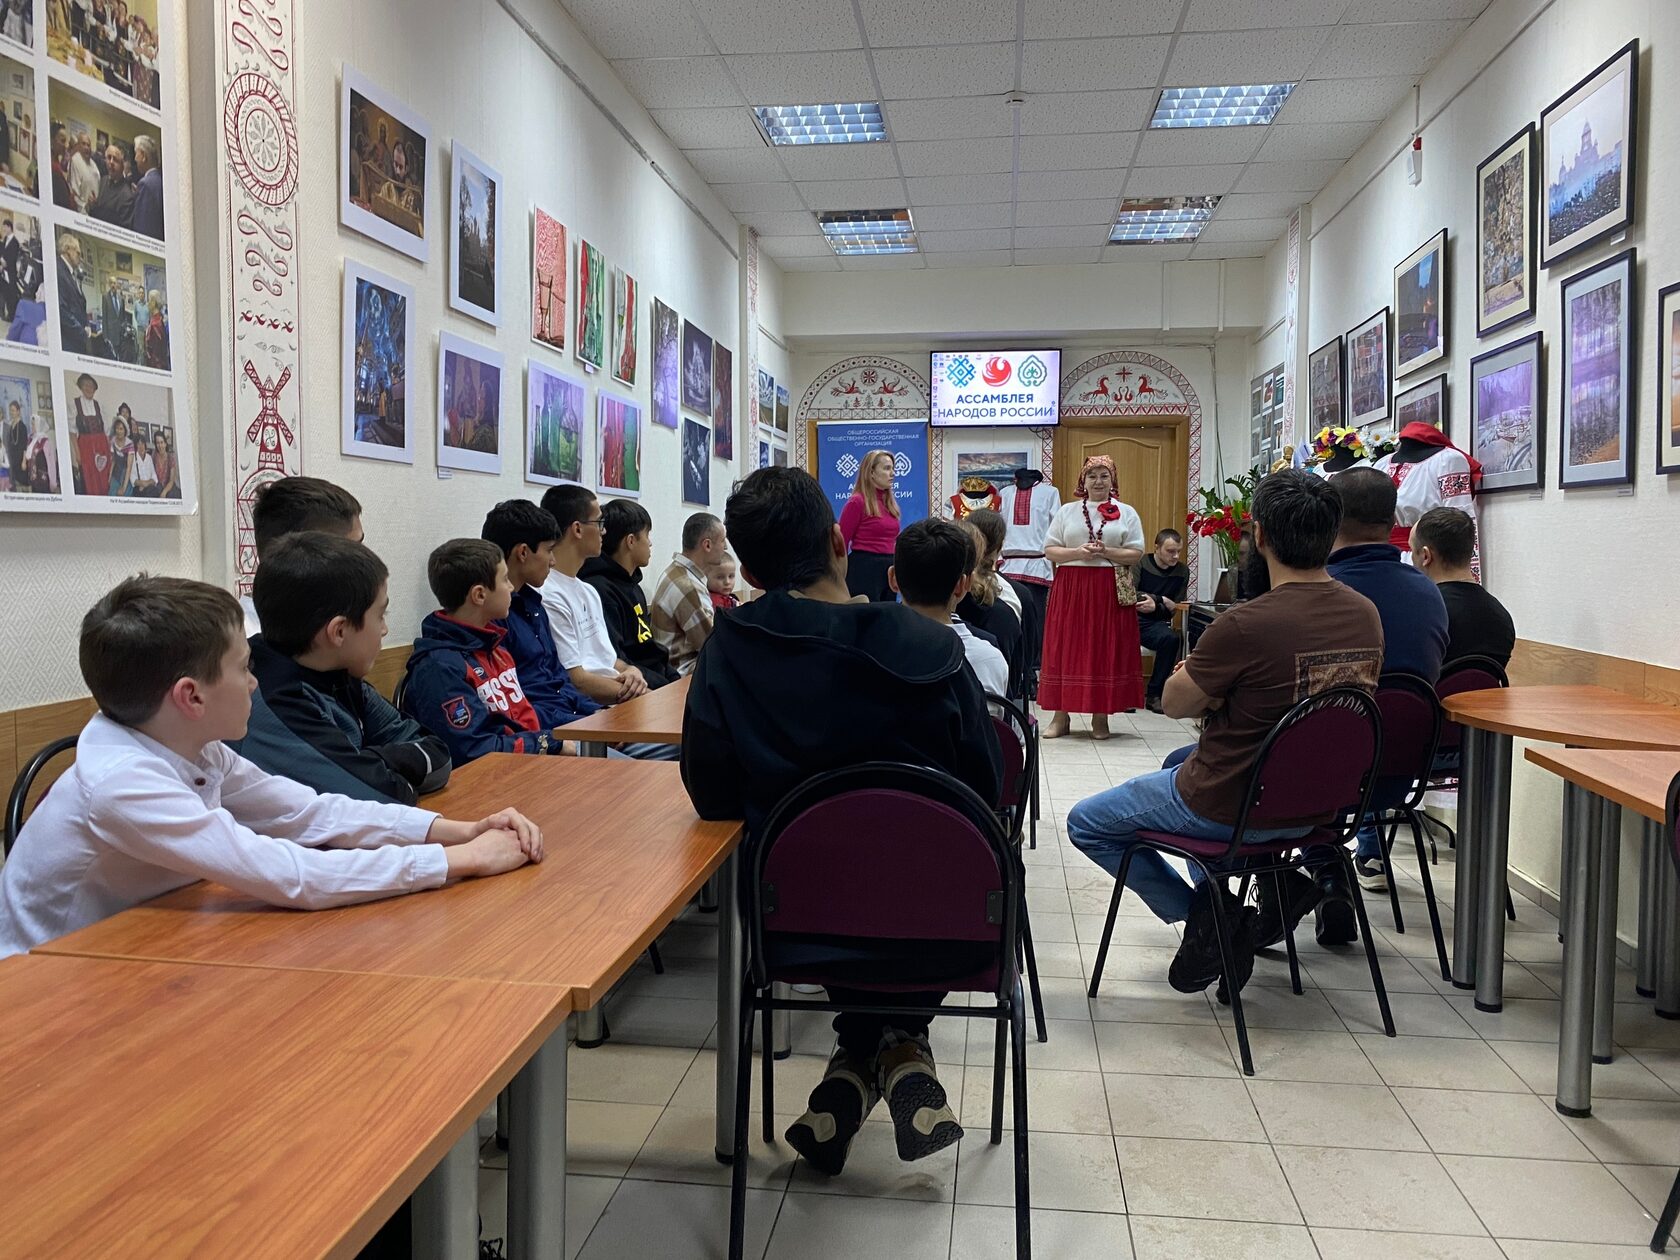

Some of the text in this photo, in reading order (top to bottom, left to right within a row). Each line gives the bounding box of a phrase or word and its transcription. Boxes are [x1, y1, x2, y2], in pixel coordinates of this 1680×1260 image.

[956, 393, 1034, 404] АССАМБЛЕЯ
[937, 406, 1053, 419] НАРОДОВ РОССИИ
[827, 434, 920, 442] ОБЩЕСТВЕННО-ГОСУДАРСТВЕННАЯ
